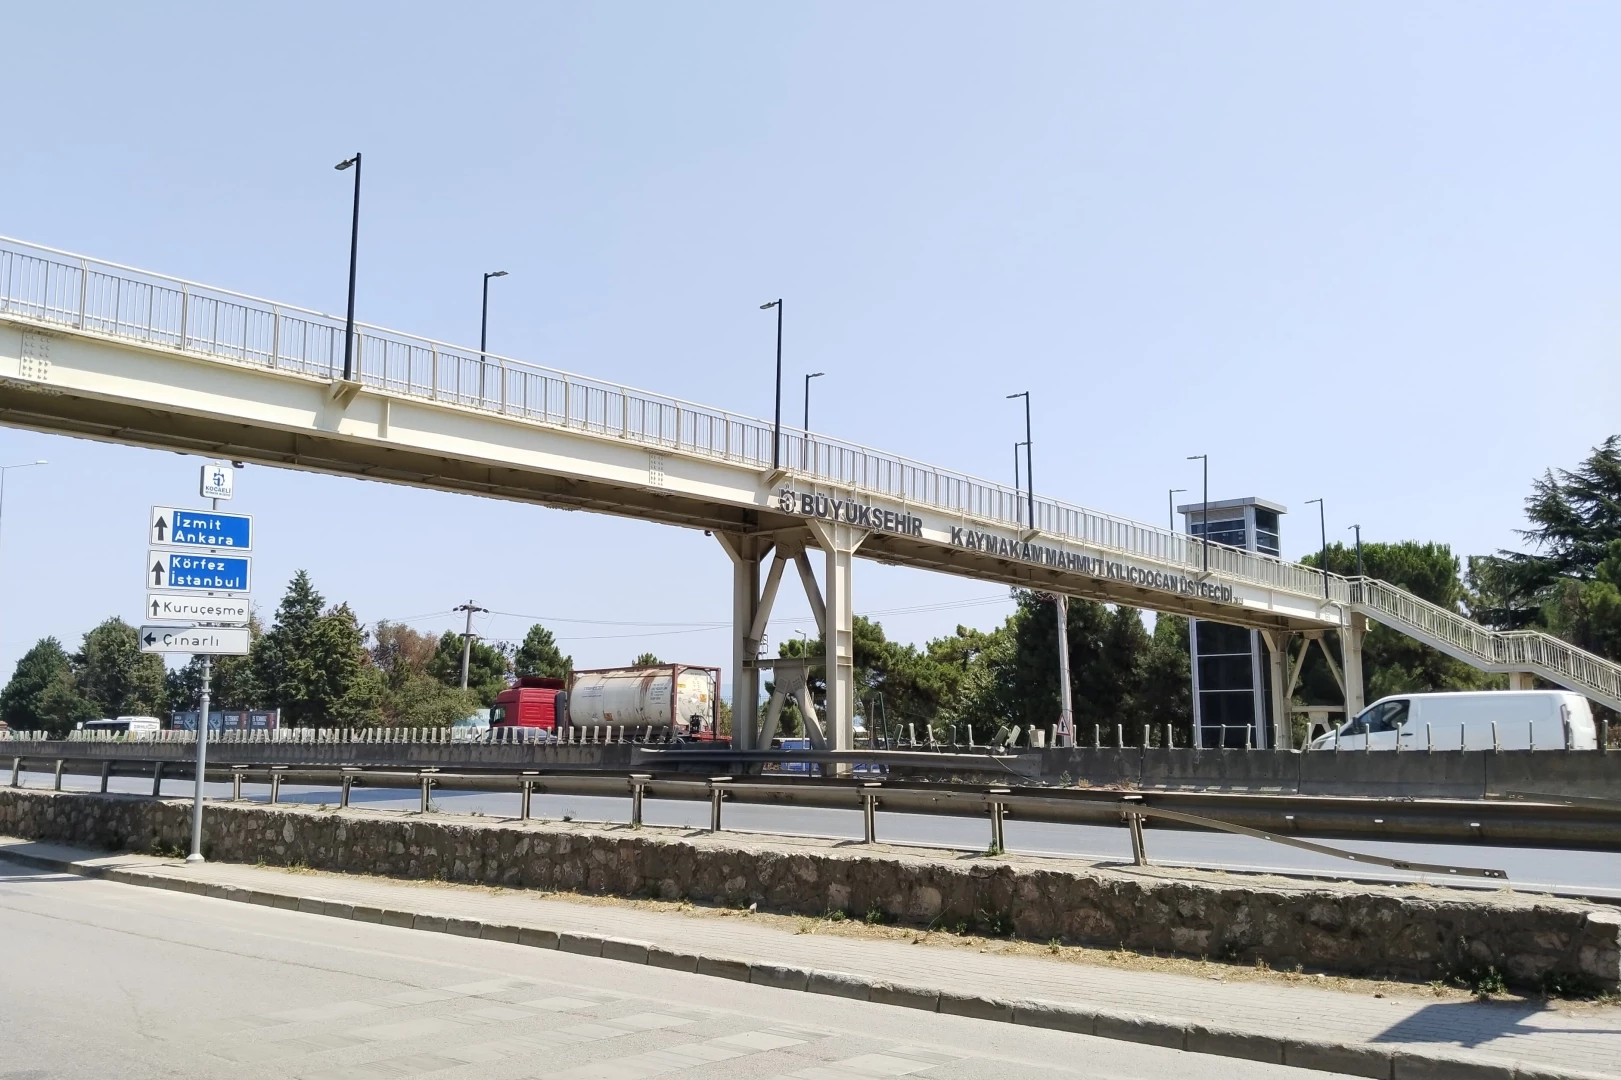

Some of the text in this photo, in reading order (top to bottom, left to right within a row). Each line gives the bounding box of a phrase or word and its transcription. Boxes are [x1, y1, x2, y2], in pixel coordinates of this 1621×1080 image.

[205, 485, 231, 494] KOCAELİ
[176, 513, 221, 530] İzmit
[801, 493, 923, 537] BÜYÜKŞEHİR
[175, 530, 234, 546] Ankara
[172, 557, 225, 571] Körfez
[951, 525, 1043, 561] KAYMAKAM
[1045, 548, 1105, 576] MAHMUT
[1107, 561, 1179, 592] KILIÇDOĞAN
[1180, 575, 1233, 604] ÜSTGEÇİDİ
[171, 571, 240, 587] İstanbul
[163, 602, 244, 616] Kuruçeşme
[163, 634, 219, 647] Çınarlı
